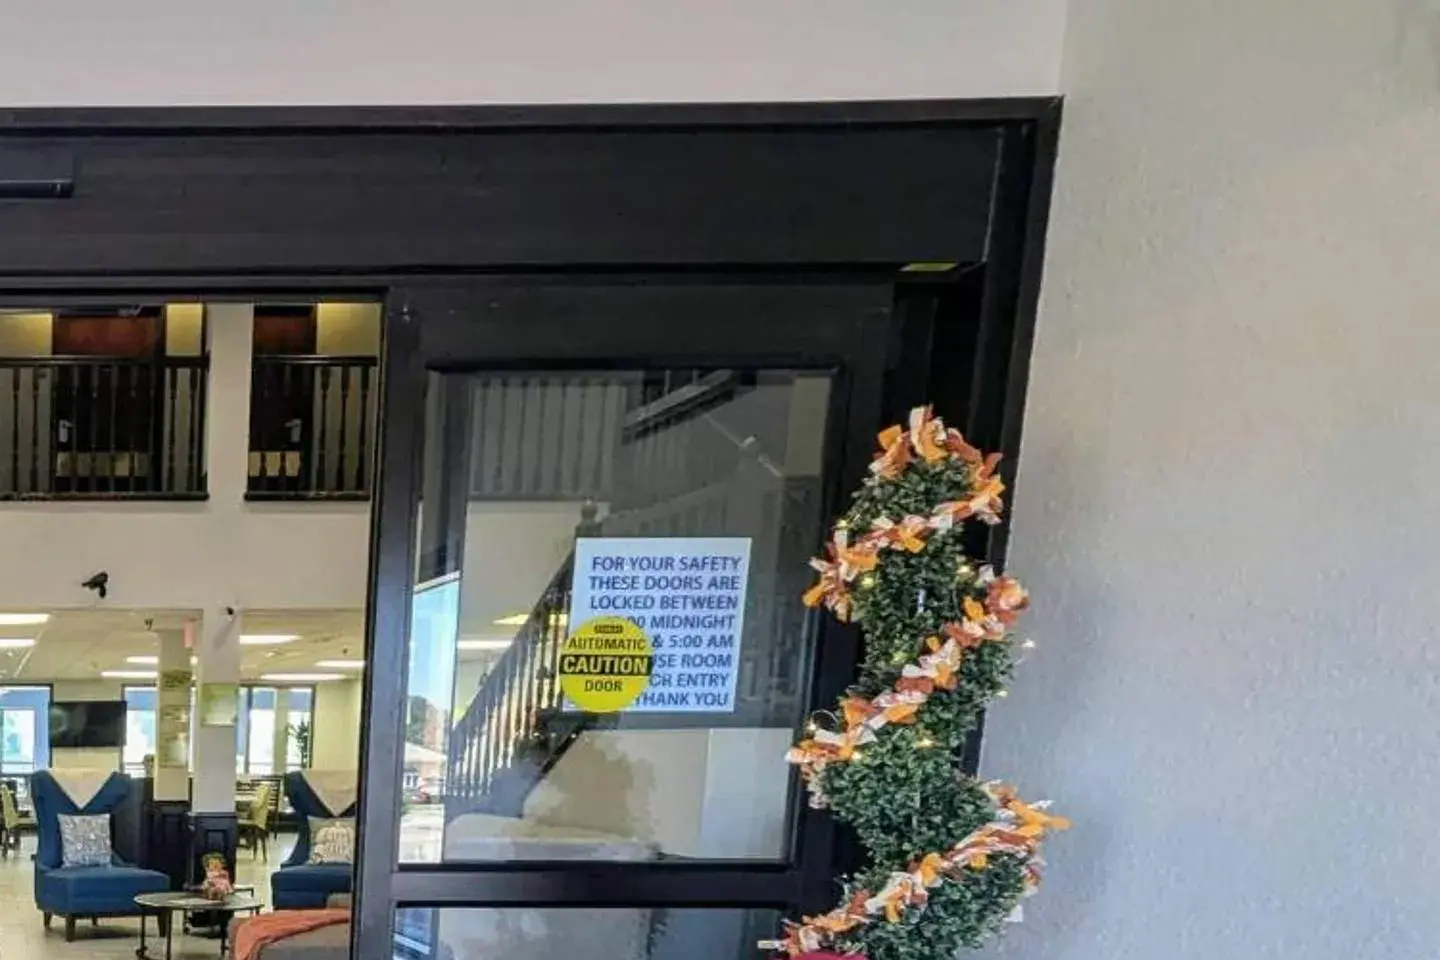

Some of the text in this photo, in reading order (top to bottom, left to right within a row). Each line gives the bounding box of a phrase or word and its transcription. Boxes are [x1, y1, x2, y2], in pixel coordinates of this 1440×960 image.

[592, 556, 742, 571] FOR YOUR SAFETY
[588, 576, 741, 590] THESE DOORS ARE
[590, 595, 738, 610] LOCKED BETWEEN
[650, 614, 735, 629] MIDNIGHT
[568, 637, 646, 650] AUTOMATIC
[652, 633, 734, 648] & 5:00 AM
[563, 655, 648, 673] CAUTION
[681, 653, 732, 668] ROOM
[584, 679, 623, 692] DOOR
[677, 673, 730, 687] ENTRY
[694, 692, 729, 706] YOU
